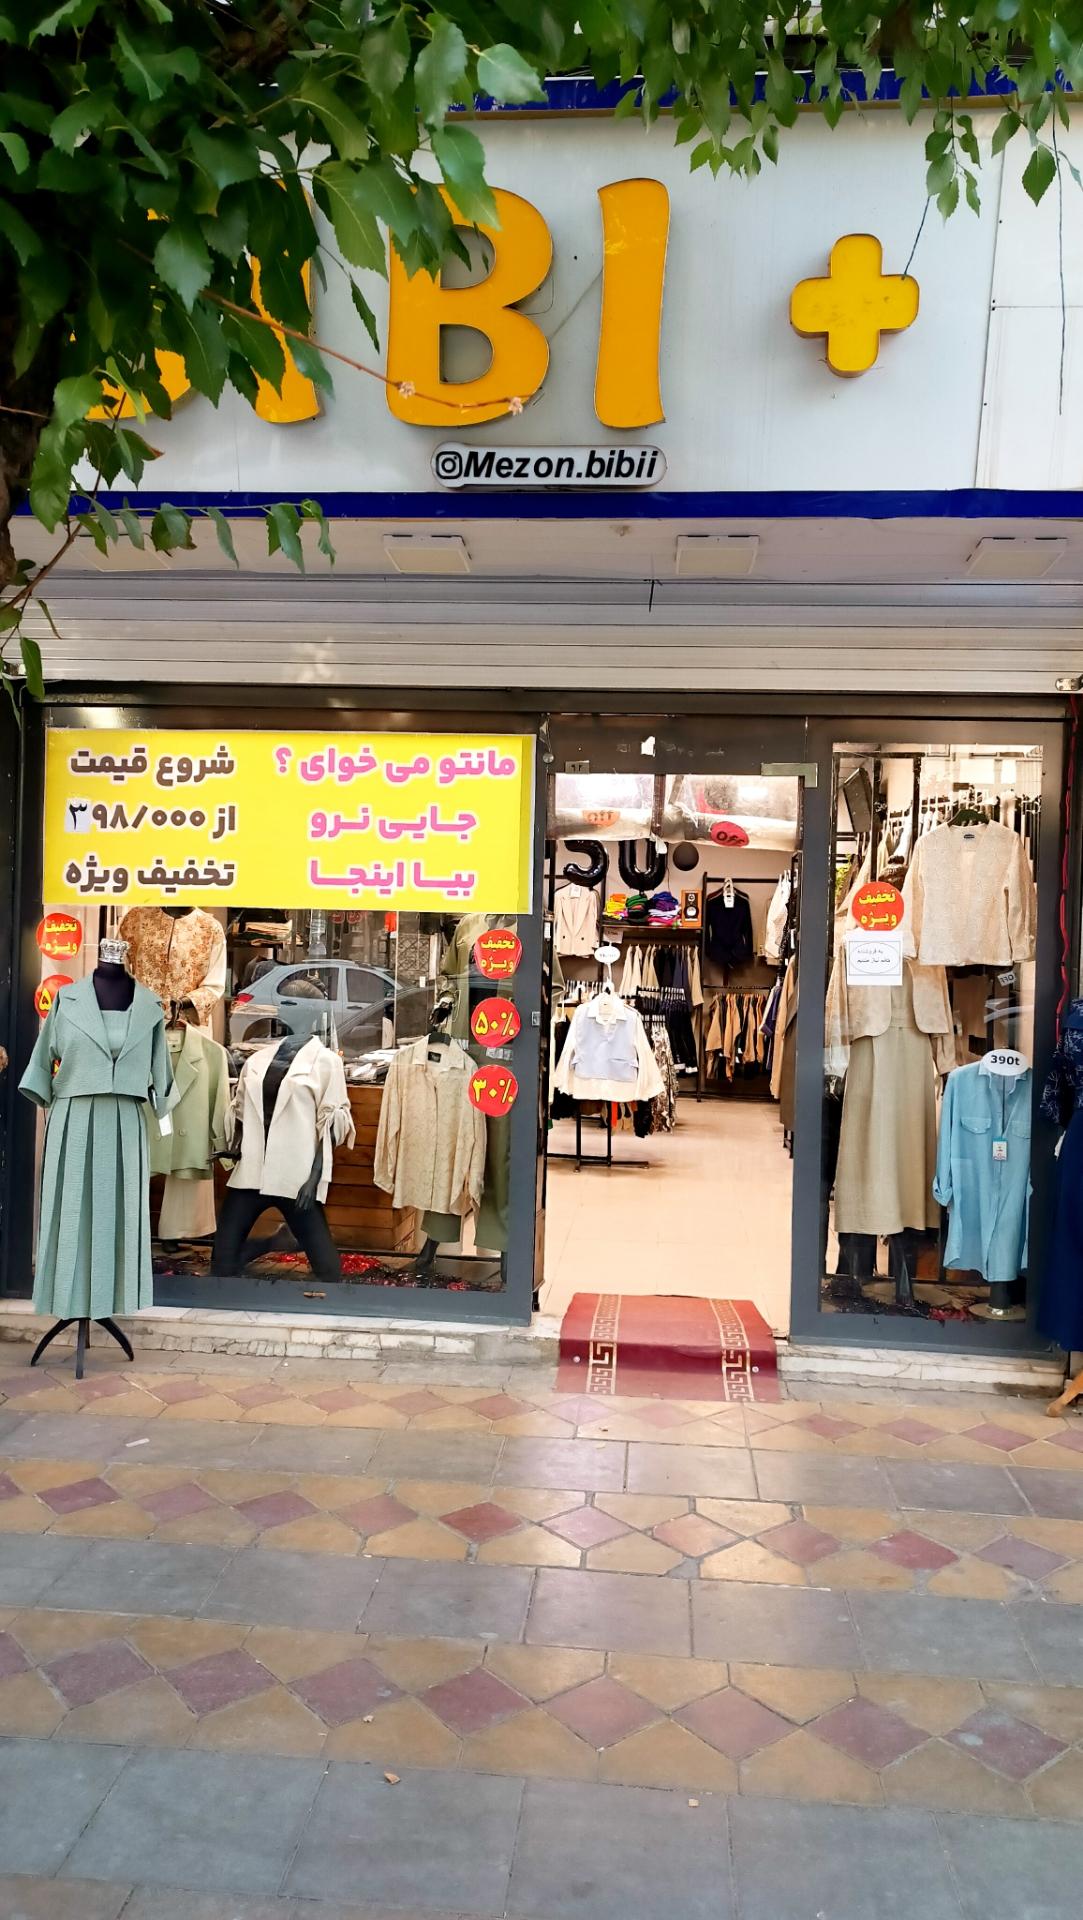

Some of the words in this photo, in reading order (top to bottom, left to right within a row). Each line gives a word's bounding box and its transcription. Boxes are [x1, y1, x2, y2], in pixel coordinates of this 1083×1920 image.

[463, 450, 659, 479] Mezon.bibii
[71, 747, 147, 781] قیمت
[156, 746, 234, 786] شروع
[300, 747, 377, 782] خوای
[385, 757, 430, 782] می
[439, 750, 515, 784] مانتو
[212, 805, 236, 839] از
[311, 807, 370, 838] نرو
[379, 806, 477, 839] جایی
[65, 855, 129, 893] ویژه
[137, 859, 235, 893] تخفیف
[310, 860, 404, 894] اینجا
[413, 862, 475, 896] بیا
[859, 889, 896, 907] تخفیف
[45, 919, 77, 935] تخفیف
[860, 911, 897, 928] ویژه
[45, 939, 77, 955] ویژه
[481, 936, 515, 952] تخفیف
[480, 956, 515, 973] ویژه
[990, 1054, 1021, 1065] 390t
